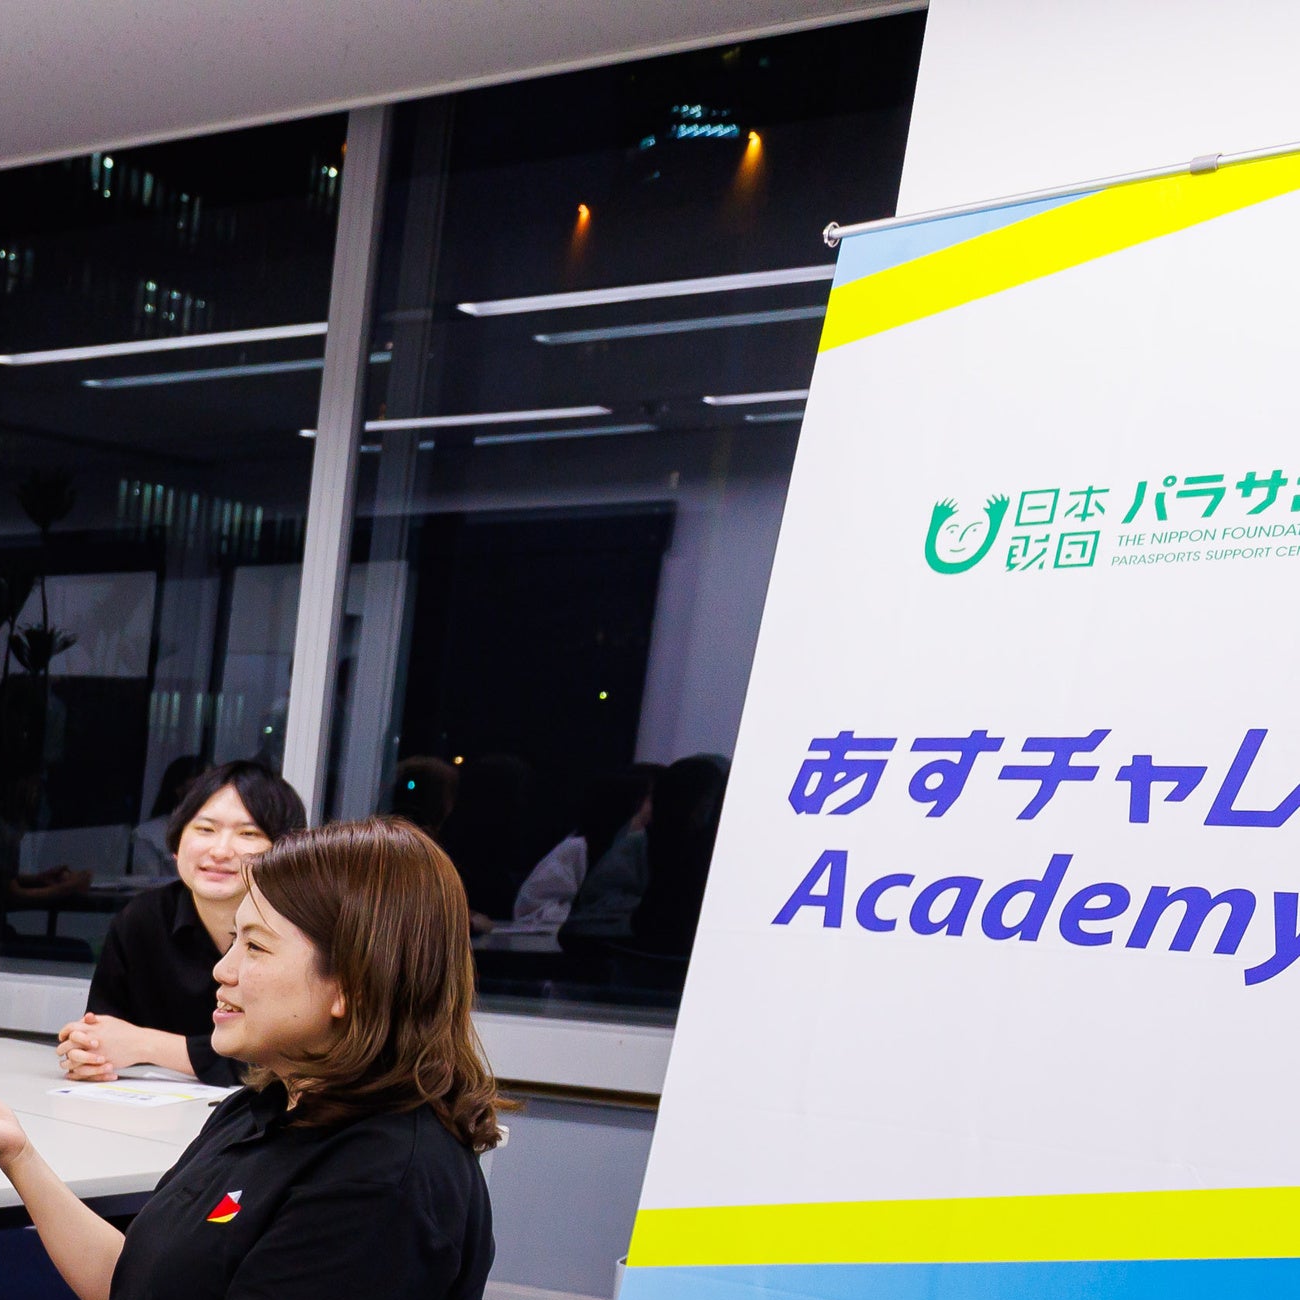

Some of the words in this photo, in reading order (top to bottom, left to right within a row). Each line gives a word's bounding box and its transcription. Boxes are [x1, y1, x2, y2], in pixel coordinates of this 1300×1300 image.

[1014, 485, 1109, 527] 日本
[1120, 468, 1300, 524] パラサ
[1118, 533, 1146, 547] THE
[1150, 528, 1217, 545] NIPPON
[1111, 550, 1201, 566] PARASPORTS
[1205, 546, 1272, 561] SUPPORT
[1275, 545, 1300, 557] CE
